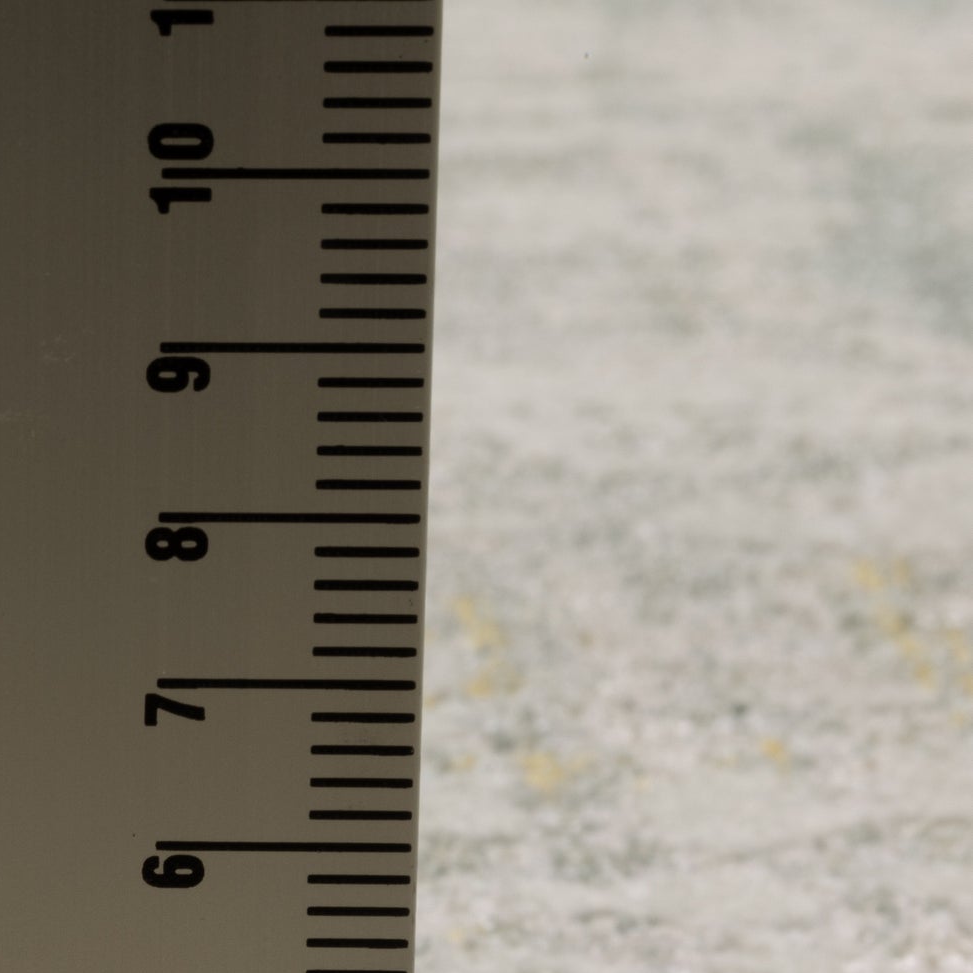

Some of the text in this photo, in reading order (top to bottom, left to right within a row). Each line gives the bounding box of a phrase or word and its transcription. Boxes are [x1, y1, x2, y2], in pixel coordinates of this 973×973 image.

[148, 123, 214, 214] 10
[146, 356, 210, 393] 9
[145, 527, 208, 561] 8
[142, 693, 205, 726] 7
[142, 855, 204, 888] 6
